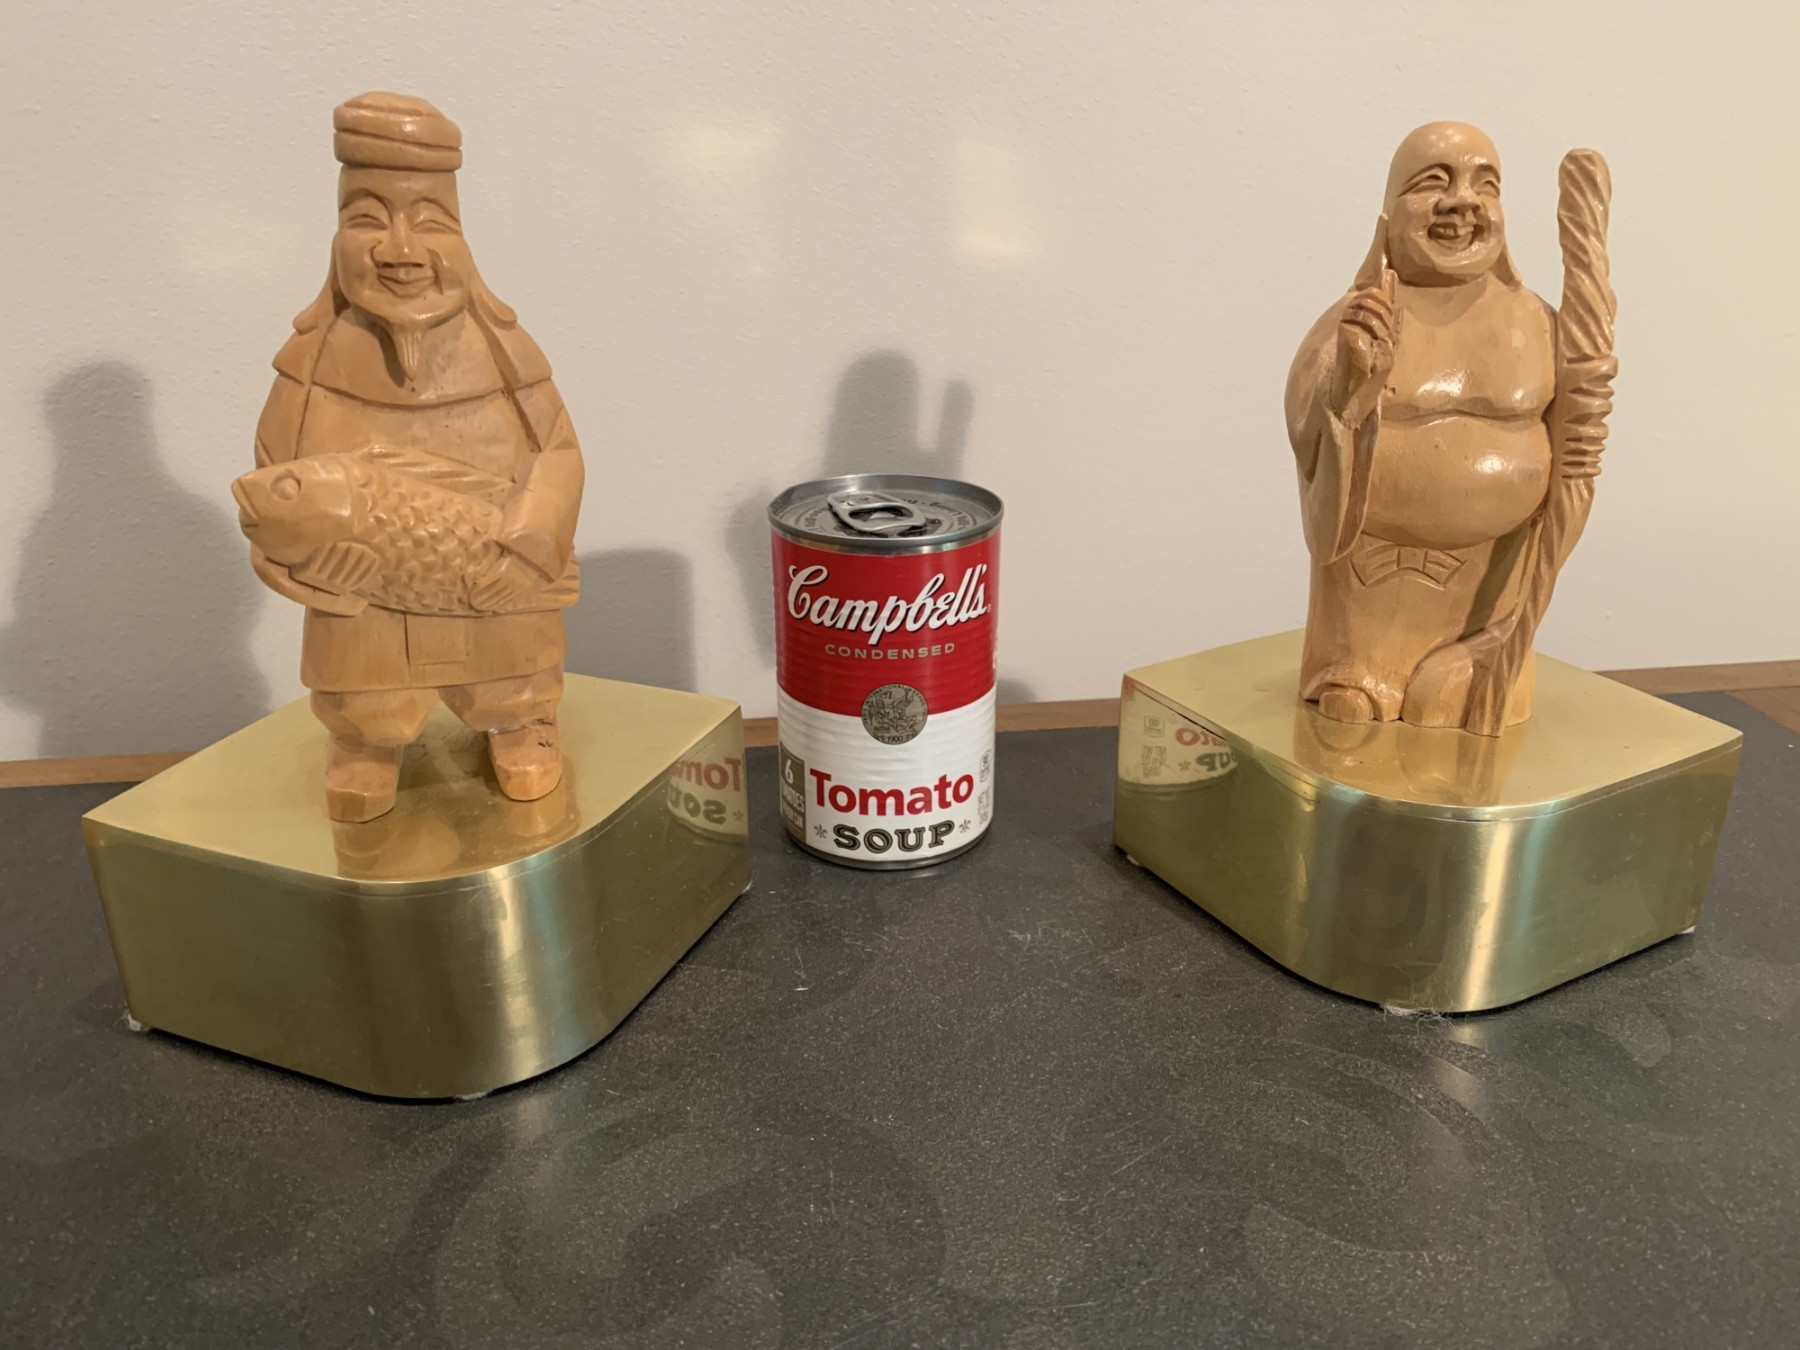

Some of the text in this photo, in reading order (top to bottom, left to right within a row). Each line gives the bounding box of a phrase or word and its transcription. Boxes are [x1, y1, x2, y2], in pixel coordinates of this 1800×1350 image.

[788, 564, 987, 645] Campbell's
[825, 643, 955, 660] CONDENSED
[887, 735, 904, 743] 1900
[784, 759, 794, 783] 6
[810, 767, 974, 816] Tomato
[832, 820, 955, 854] SOUP
